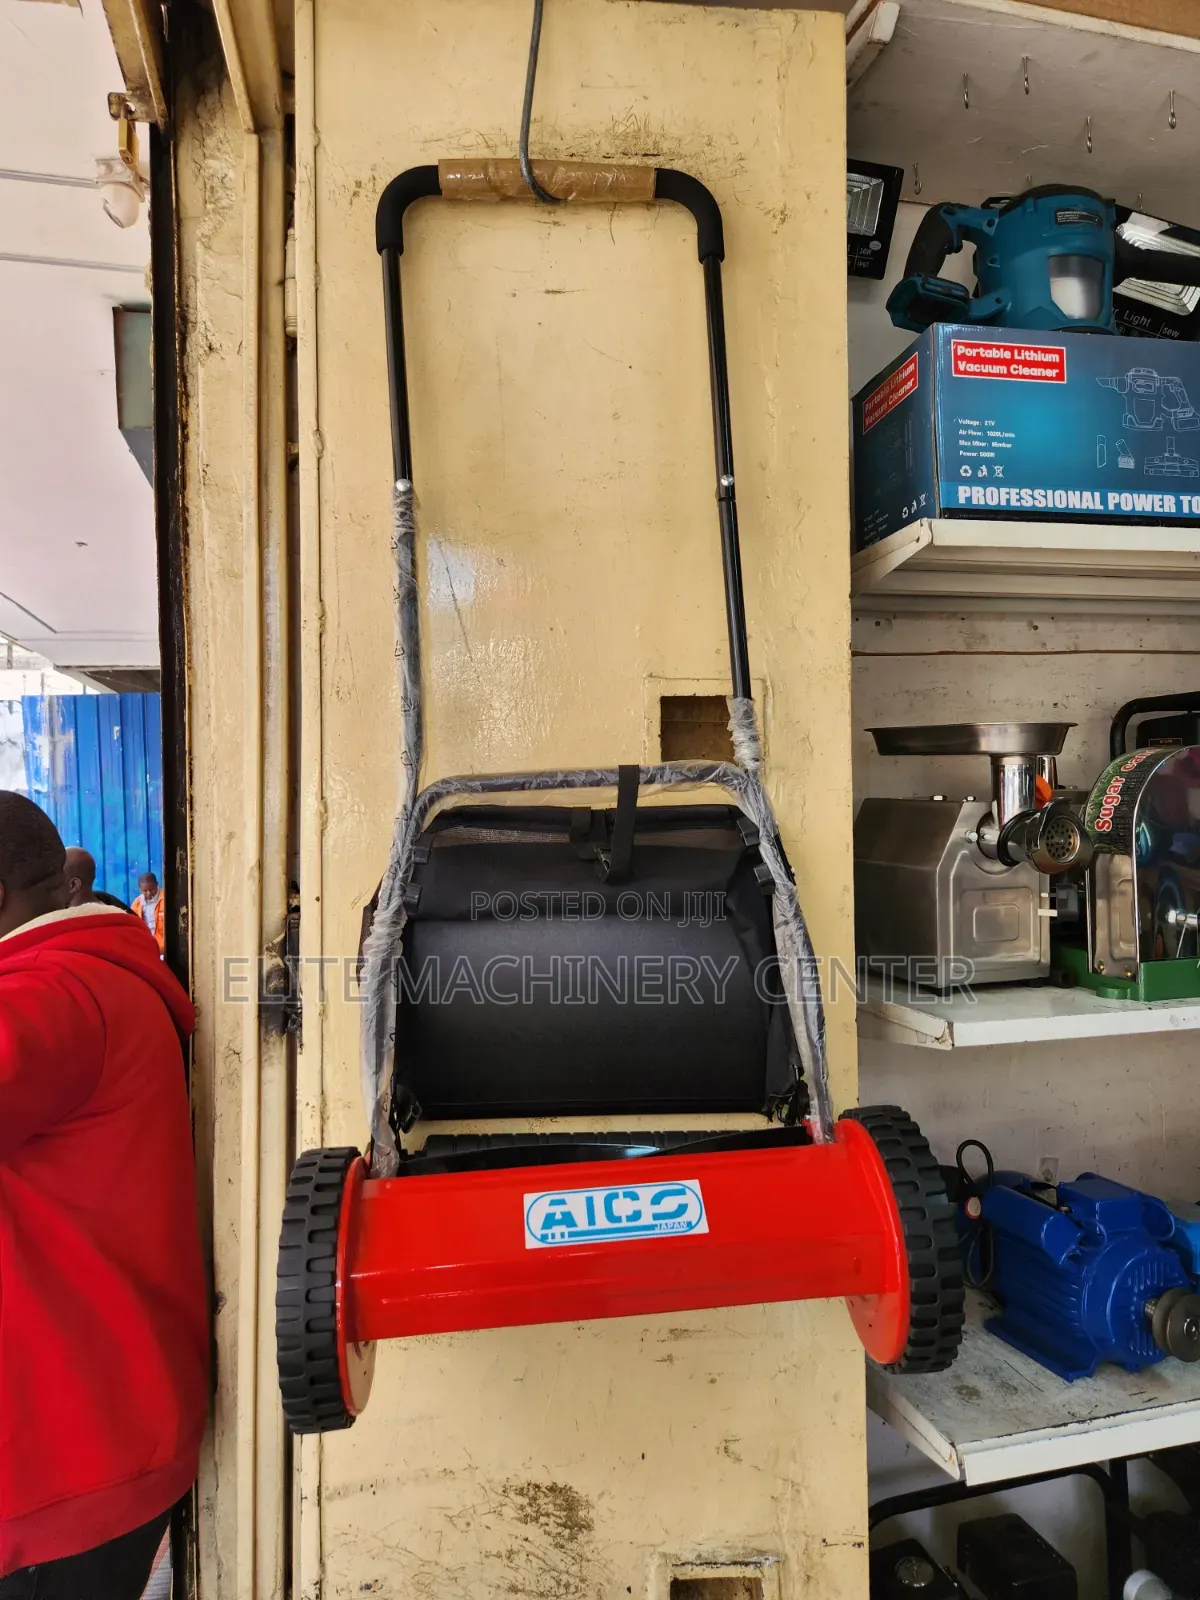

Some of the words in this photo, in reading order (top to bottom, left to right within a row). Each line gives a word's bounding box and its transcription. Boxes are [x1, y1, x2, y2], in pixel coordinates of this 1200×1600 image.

[1123, 309, 1152, 328] Light
[957, 345, 1012, 360] Portable
[1014, 349, 1060, 363] Lithium
[890, 362, 915, 390] Lithium
[957, 360, 1008, 375] Vacuum
[1010, 364, 1060, 378] Cleaner
[888, 377, 915, 405] Cleaner
[957, 485, 1104, 511] PROFESSIONAL
[1107, 492, 1177, 513] POWER
[1095, 775, 1126, 832] Sugar
[654, 1220, 687, 1231] JAPAN
